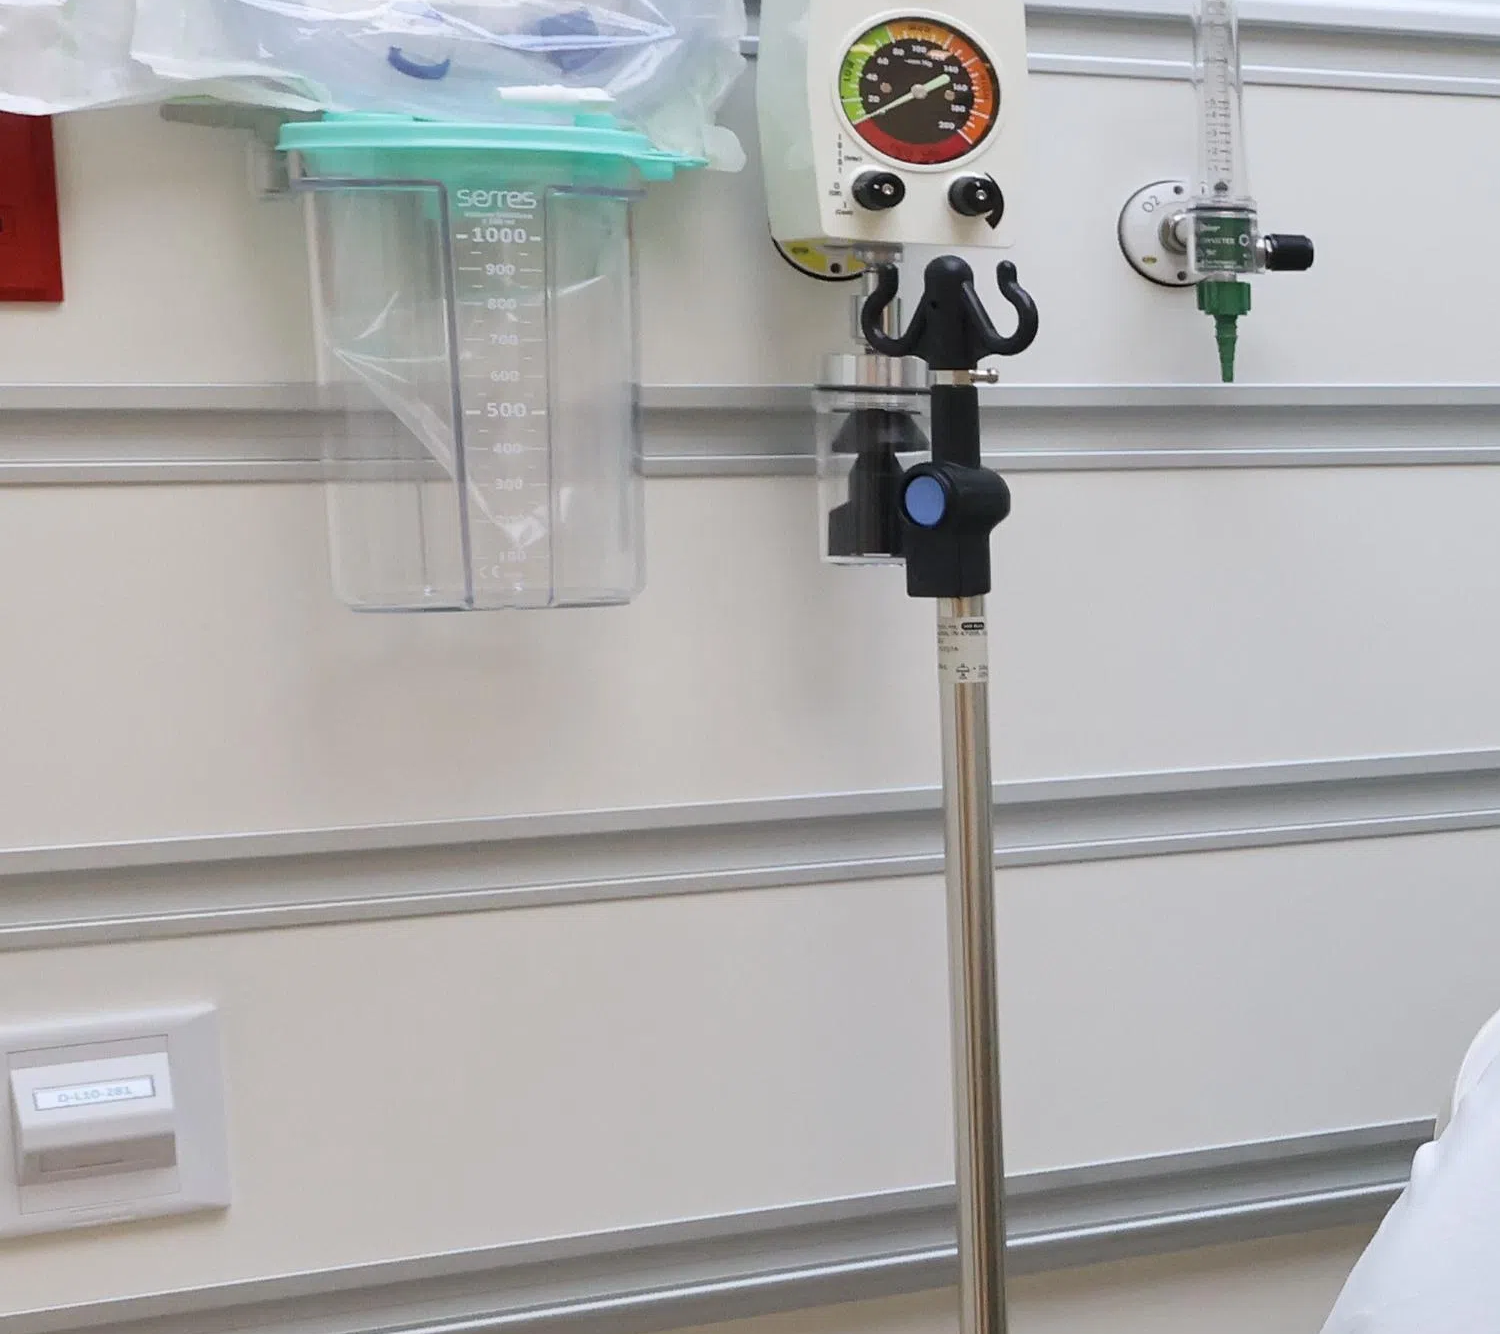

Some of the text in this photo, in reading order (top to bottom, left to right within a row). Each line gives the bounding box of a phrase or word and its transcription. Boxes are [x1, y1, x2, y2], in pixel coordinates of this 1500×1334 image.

[892, 47, 905, 56] 80
[912, 45, 928, 53] 100
[877, 57, 889, 65] 60
[943, 65, 959, 74] 140
[865, 73, 878, 81] 40
[953, 83, 968, 91] 160
[868, 95, 880, 103] 20
[951, 104, 966, 113] 180
[938, 121, 955, 129] 200
[456, 189, 537, 209] serres
[471, 227, 527, 244] 1000
[485, 264, 516, 276] 900
[487, 298, 517, 310] 800
[489, 334, 519, 346] 700
[490, 370, 519, 382] 600
[486, 402, 527, 418] 500
[493, 442, 522, 454] 400
[495, 478, 524, 491] 300
